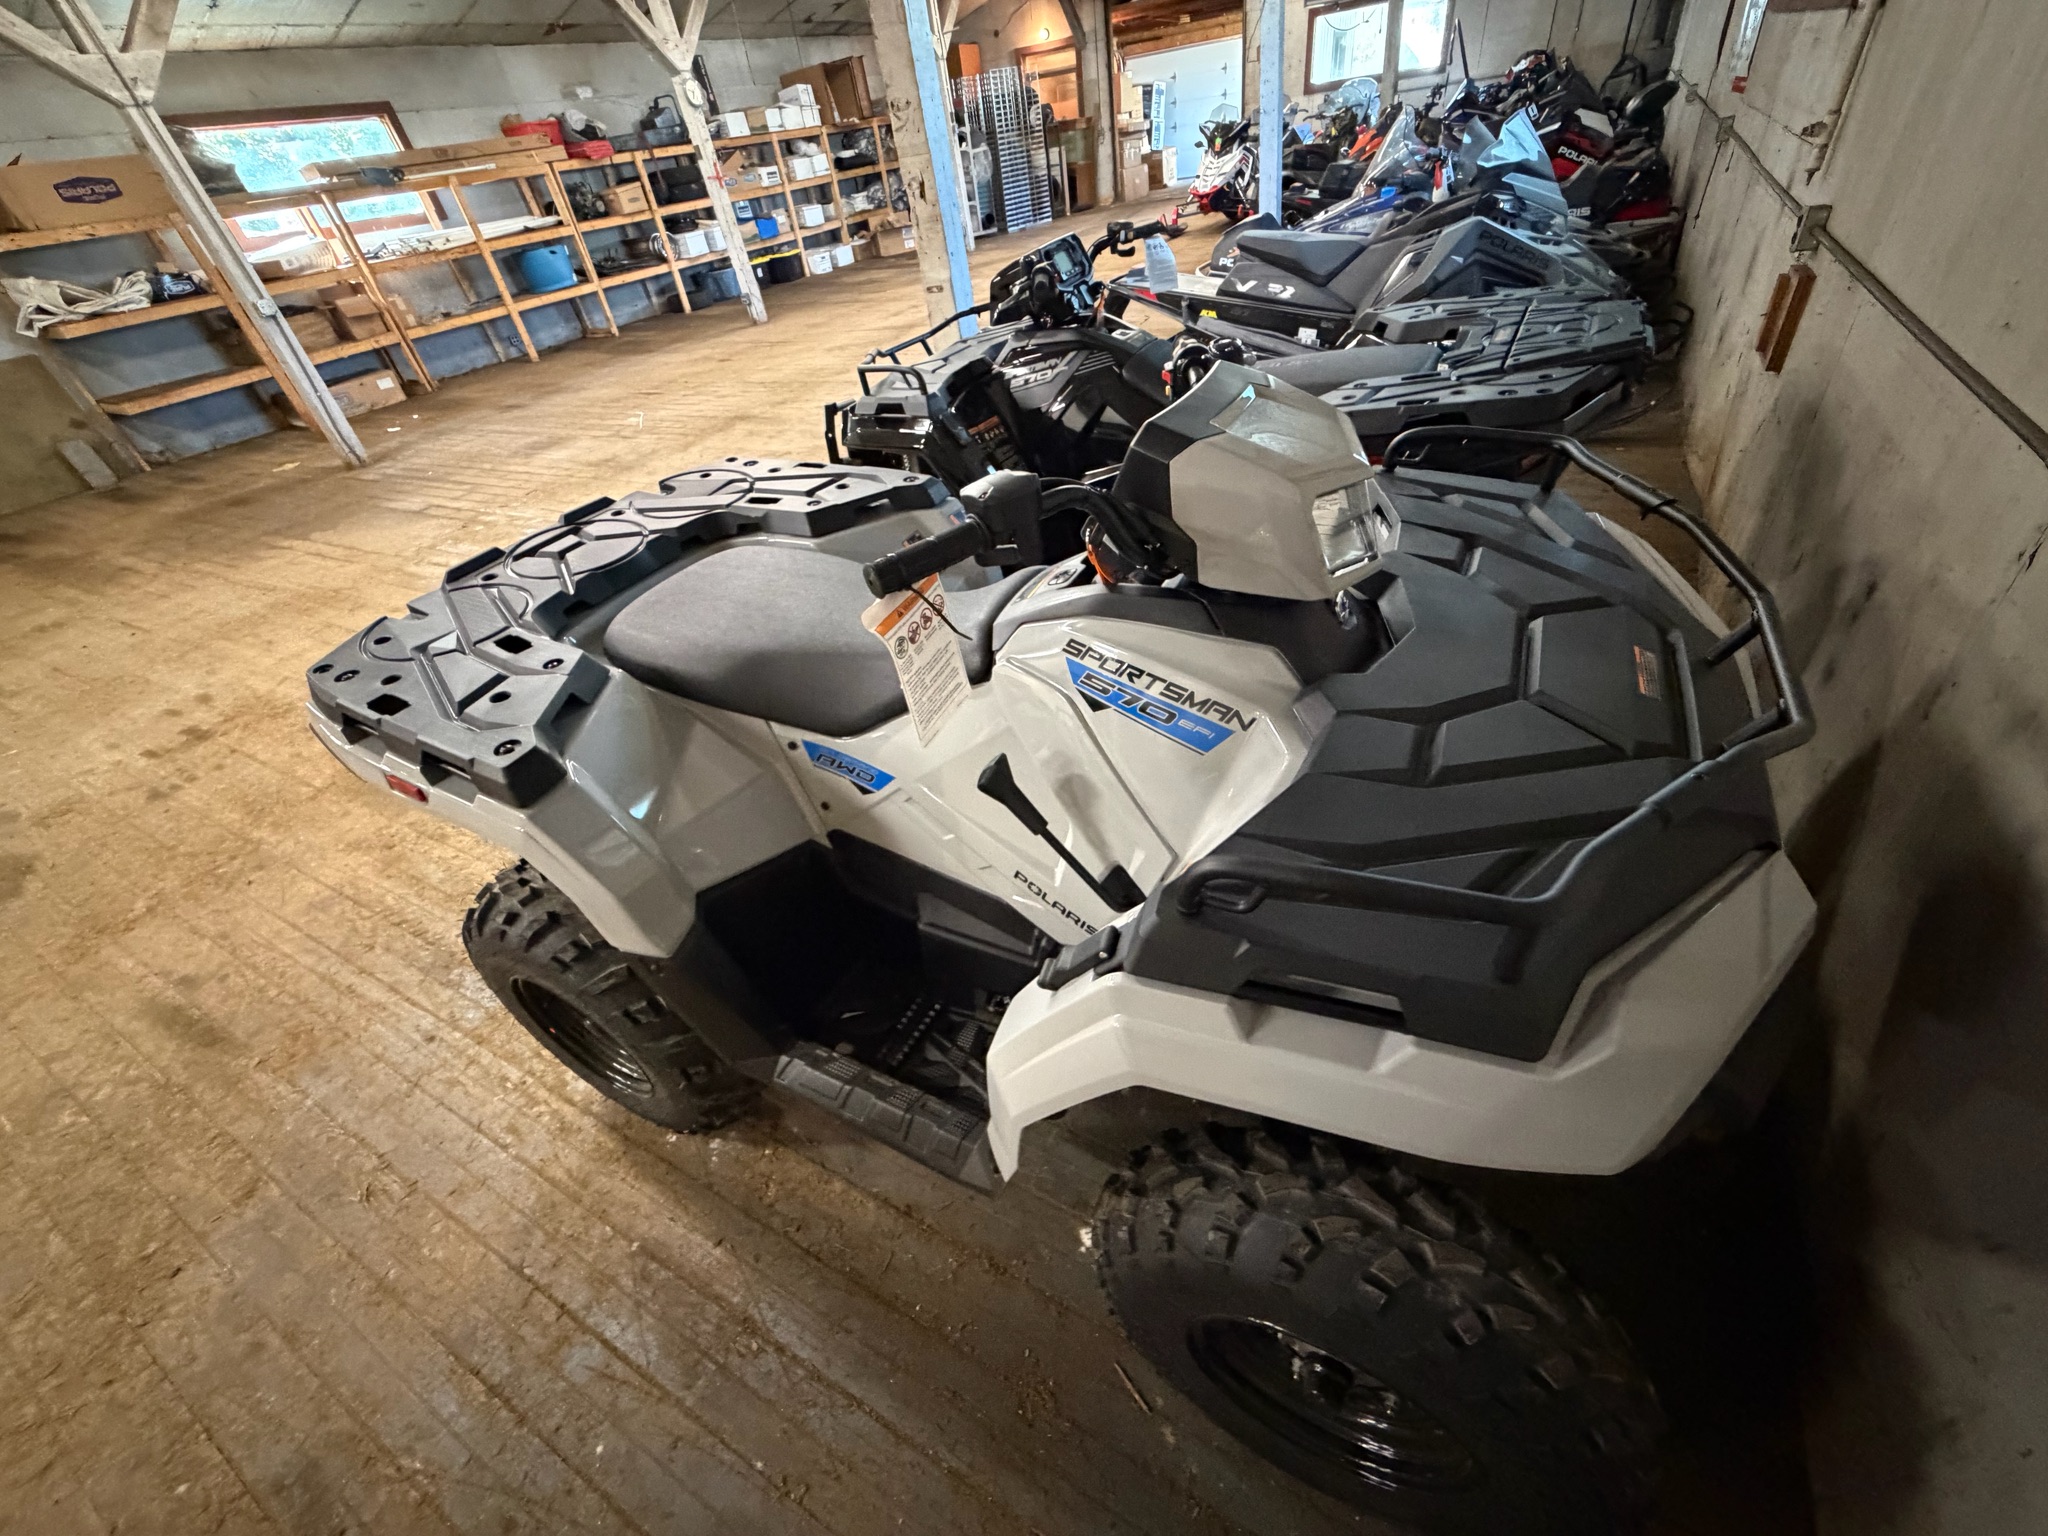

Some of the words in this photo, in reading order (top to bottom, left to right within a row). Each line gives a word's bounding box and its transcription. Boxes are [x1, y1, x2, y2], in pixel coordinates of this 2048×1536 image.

[1478, 229, 1550, 271] POLARIS
[1010, 368, 1053, 389] 570
[1062, 638, 1257, 732] SPORTSMAN
[1078, 671, 1179, 726] 570
[1178, 719, 1216, 740] EFI
[815, 753, 876, 783] AWD
[1013, 870, 1099, 936] POLARIS
